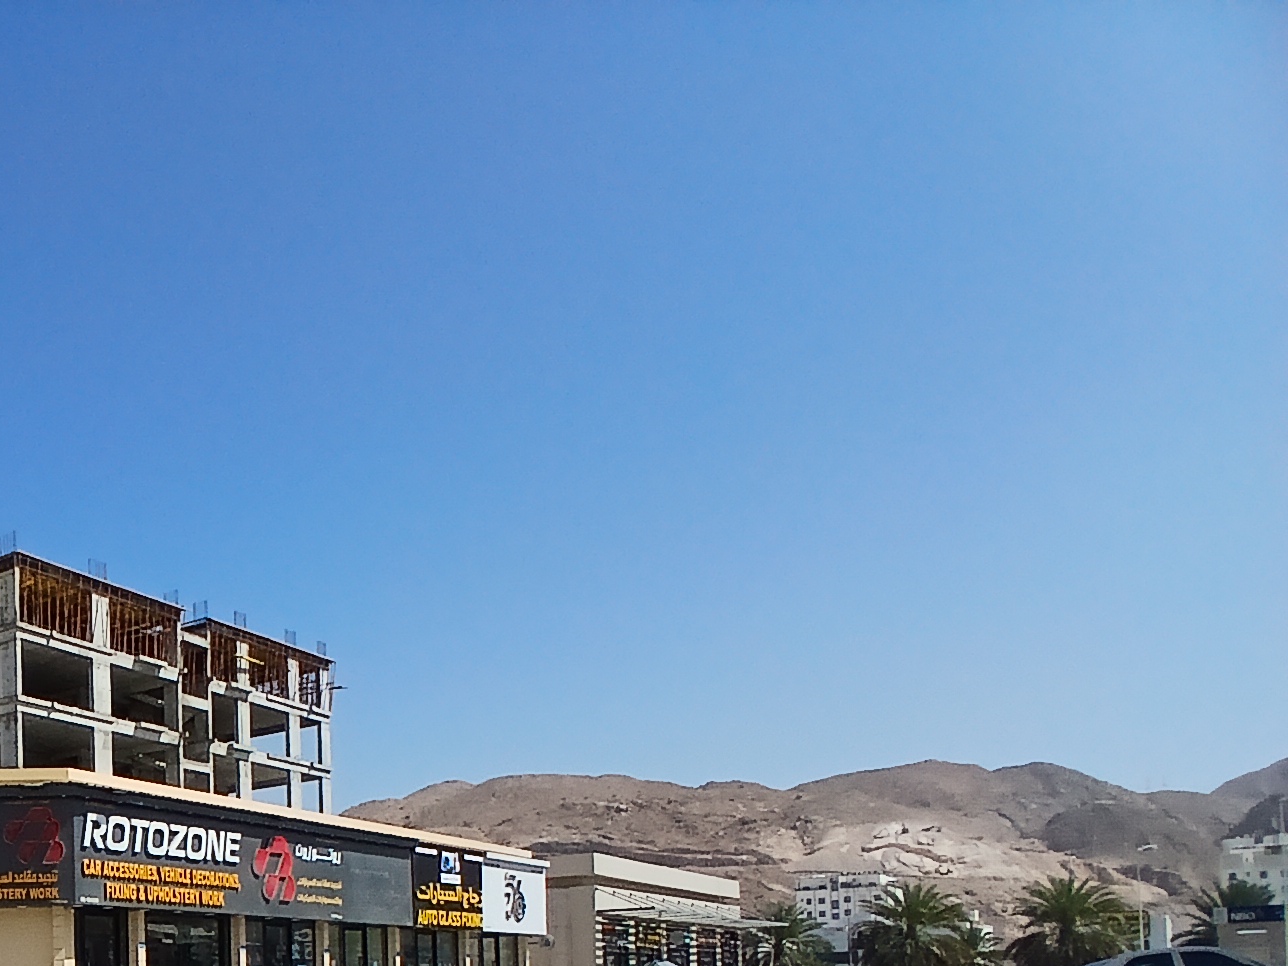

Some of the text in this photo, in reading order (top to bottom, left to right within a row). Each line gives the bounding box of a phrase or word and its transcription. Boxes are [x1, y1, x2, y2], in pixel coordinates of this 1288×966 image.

[83, 812, 242, 864] ROTOZONE
[83, 859, 102, 876] CAR
[161, 866, 191, 885] VEHICLE
[29, 887, 60, 900] WORK
[106, 882, 137, 901] FIXING
[139, 884, 145, 900] &
[147, 886, 200, 905] UPHOLSTERY
[201, 890, 225, 907] WORK
[416, 882, 462, 905] السيارات
[417, 909, 439, 926] AUTO
[438, 910, 462, 927] GLASS
